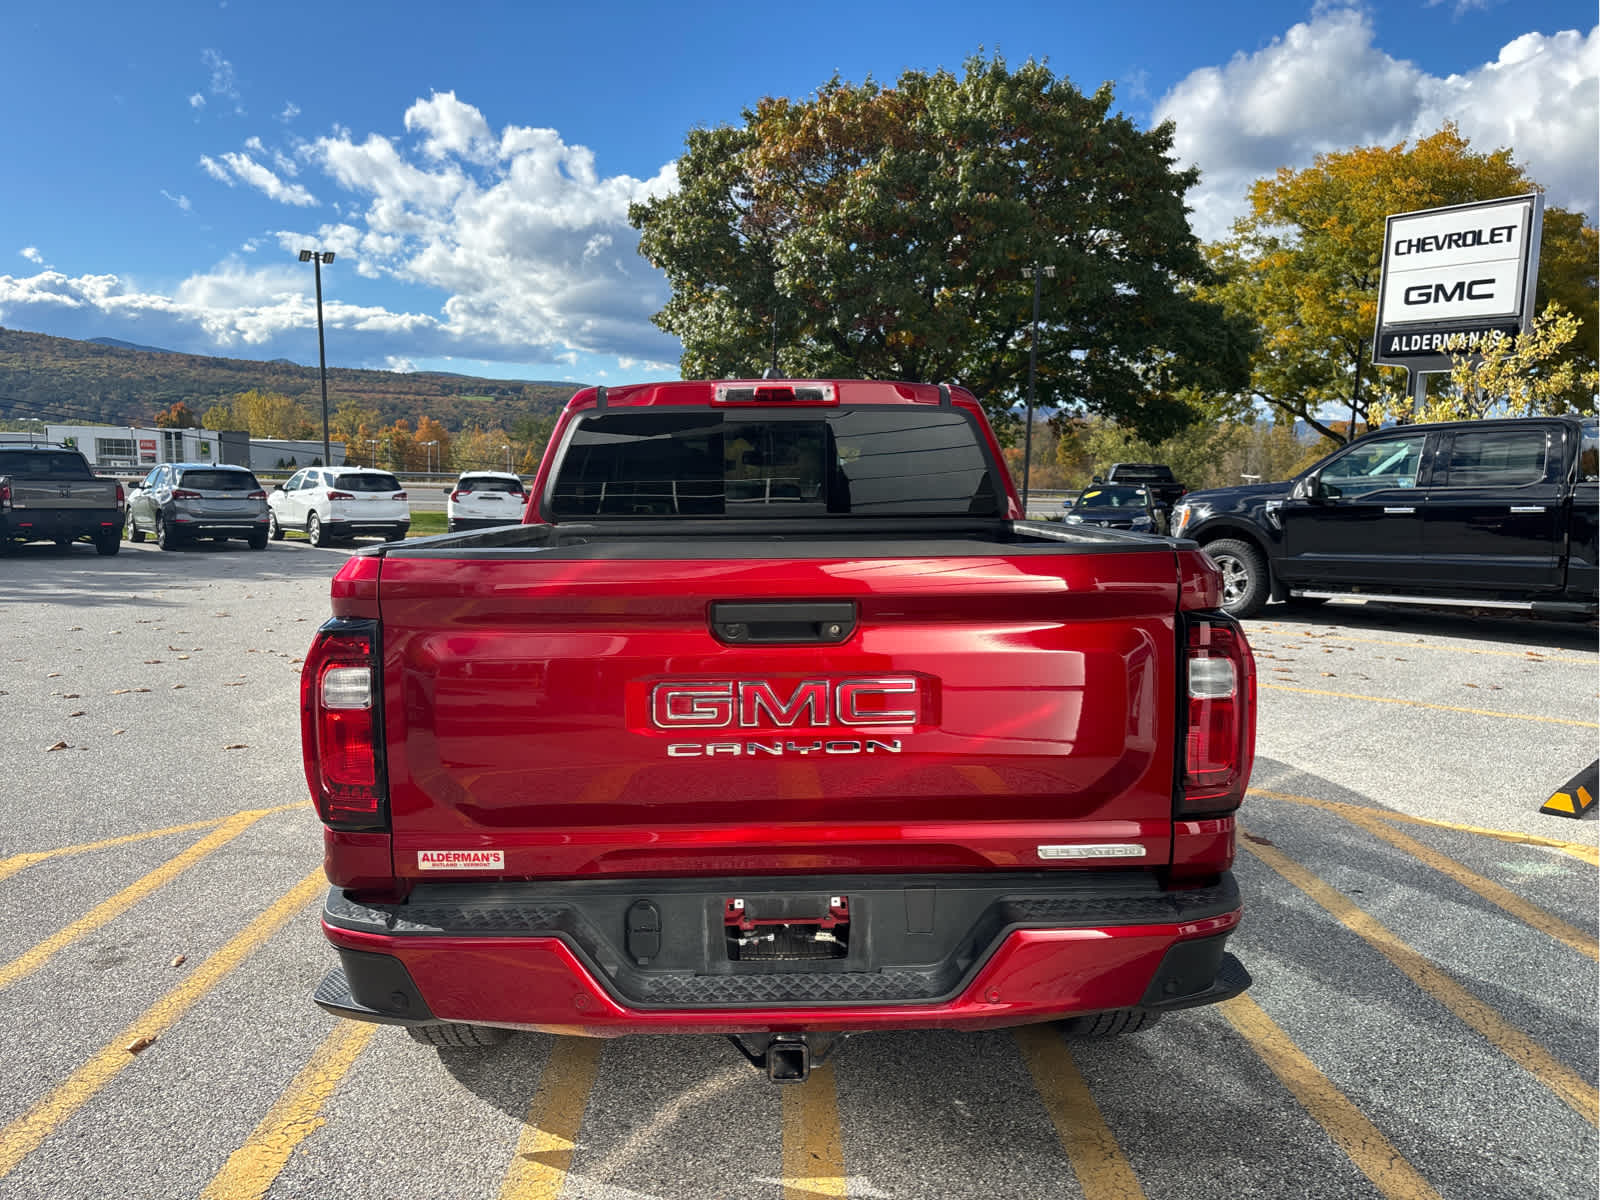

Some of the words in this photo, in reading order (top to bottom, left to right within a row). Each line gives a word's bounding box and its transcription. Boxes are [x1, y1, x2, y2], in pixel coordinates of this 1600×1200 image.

[1394, 225, 1518, 256] CHEVROLET
[1404, 278, 1496, 306] GMC
[652, 678, 917, 728] GMC
[667, 740, 902, 757] CANYON
[422, 853, 501, 862] ALDERMAN'S
[1045, 846, 1141, 857] ELEVATION
